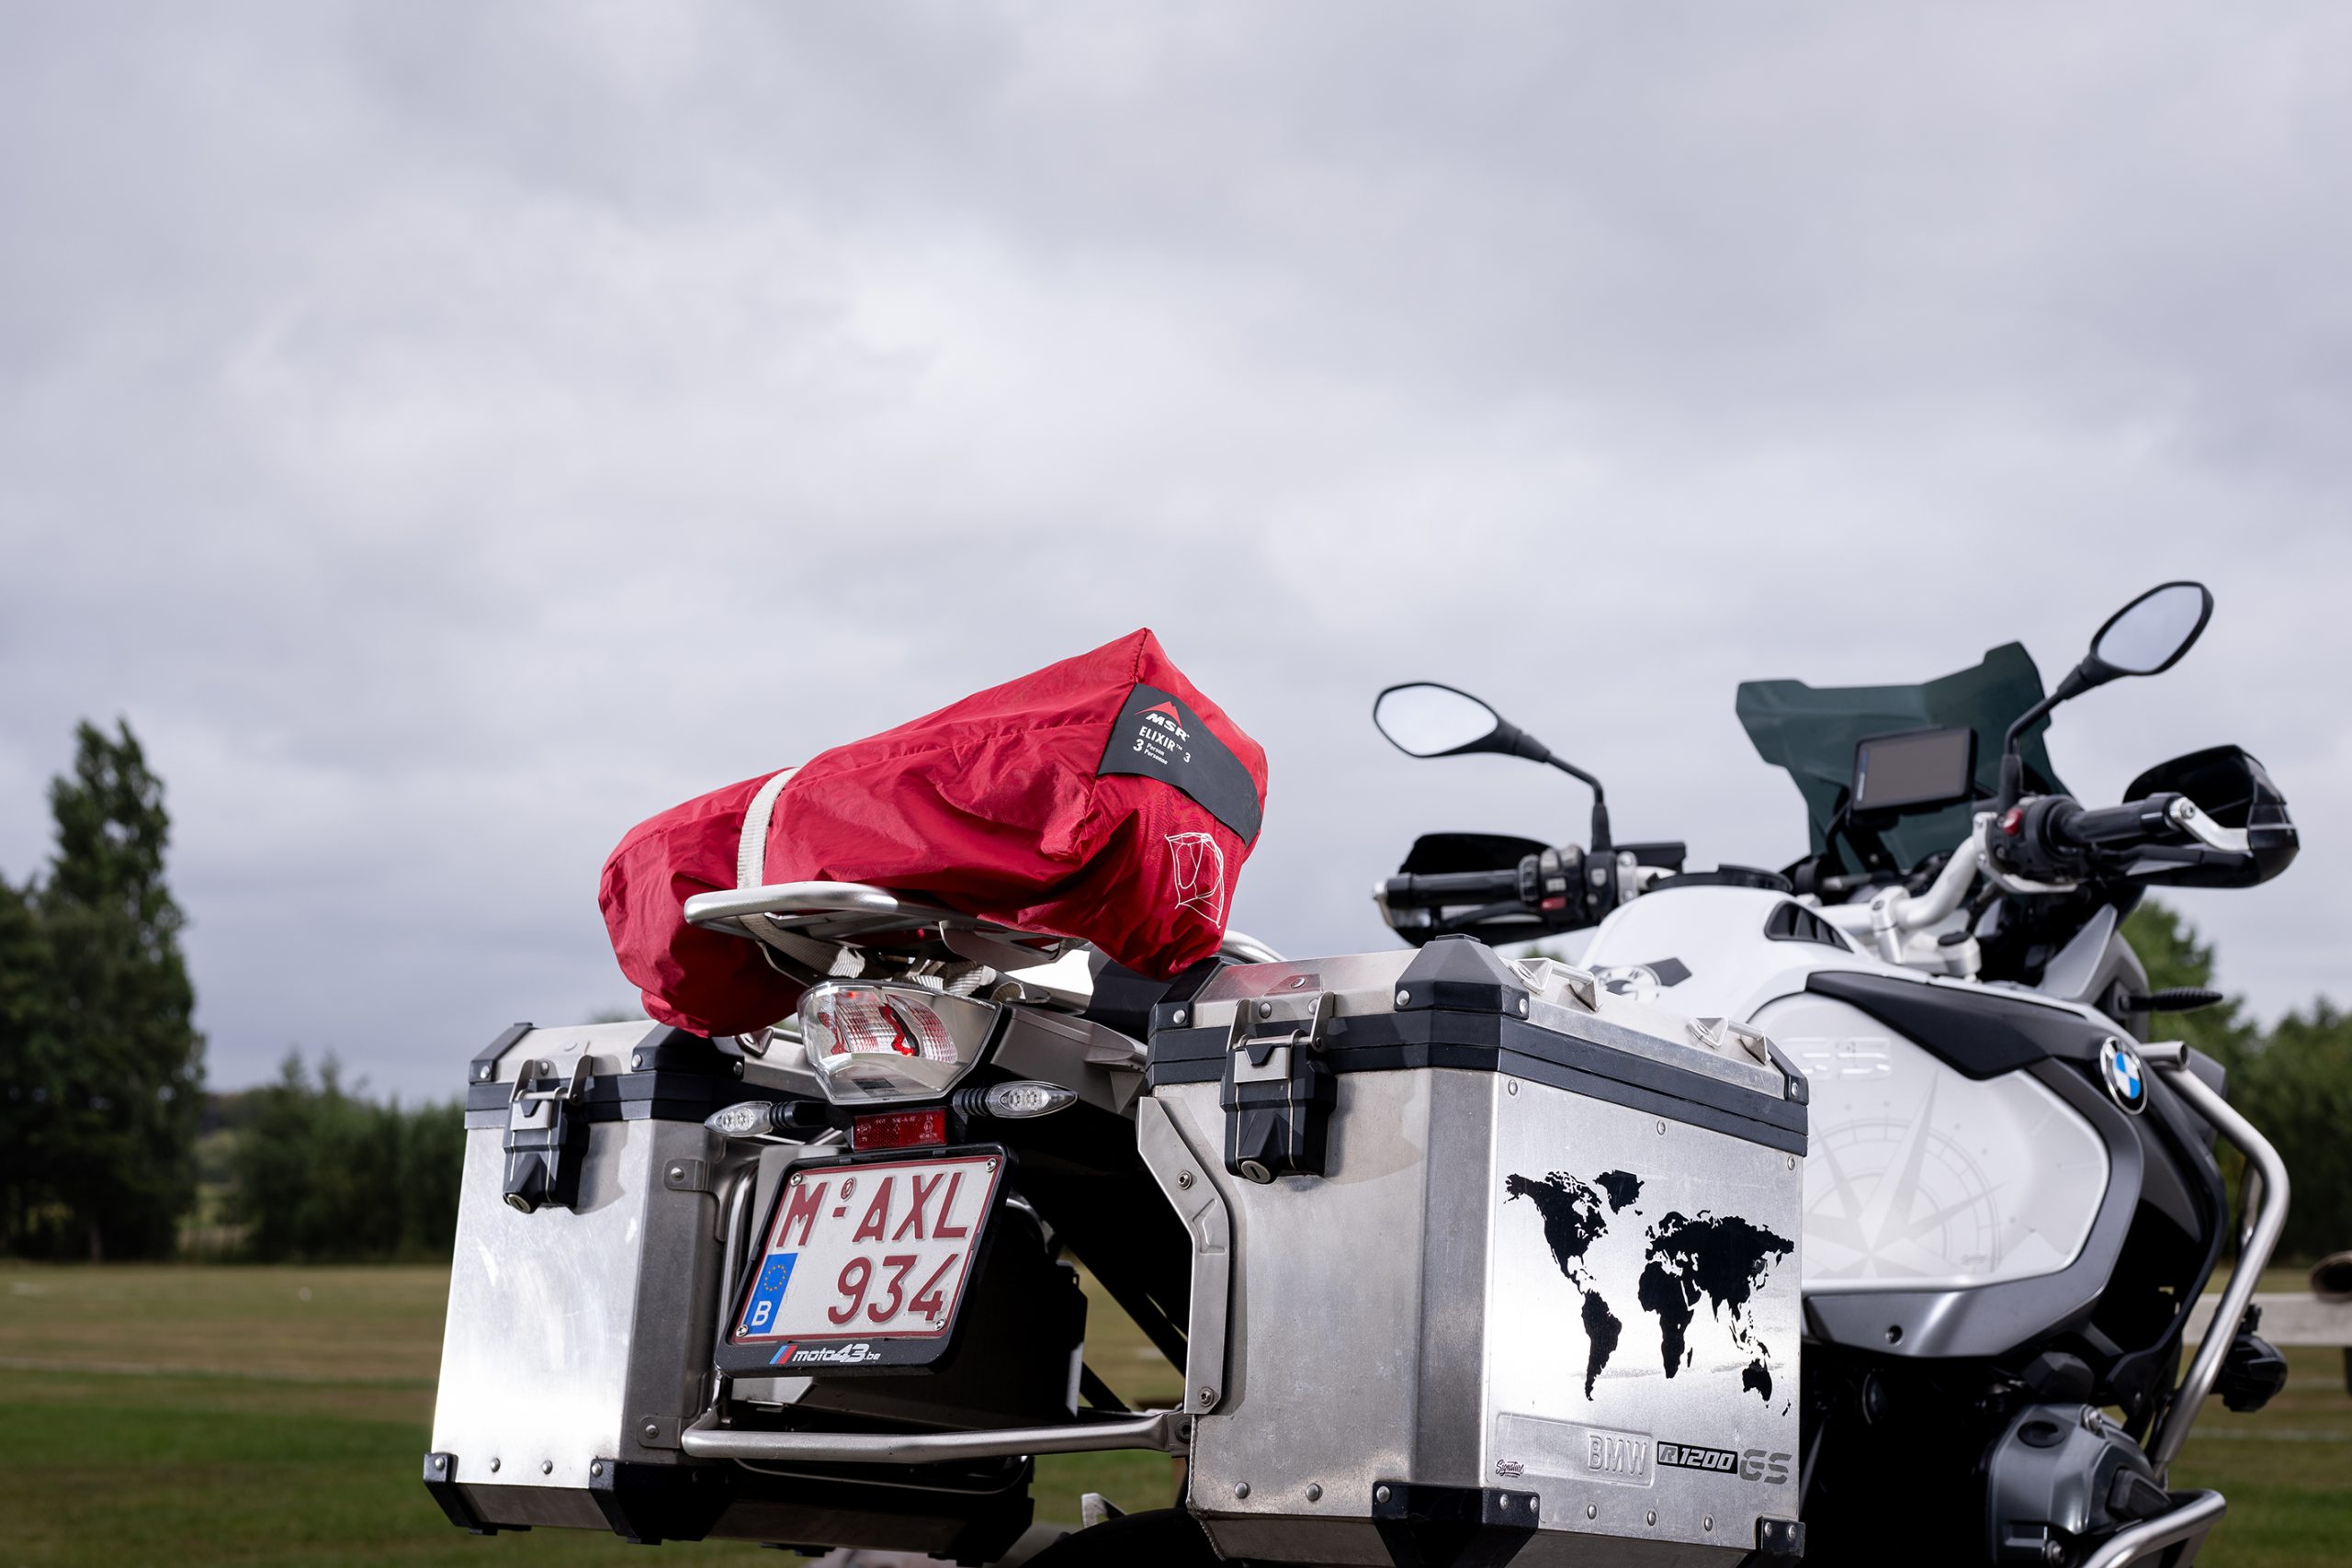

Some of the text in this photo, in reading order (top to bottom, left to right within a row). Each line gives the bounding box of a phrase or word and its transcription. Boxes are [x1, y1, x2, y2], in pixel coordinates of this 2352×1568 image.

[1133, 739, 1145, 751] 3
[1183, 752, 1192, 763] 3
[827, 1253, 959, 1325] 934
[751, 1300, 772, 1326] B
[1588, 1434, 1648, 1476] BMW
